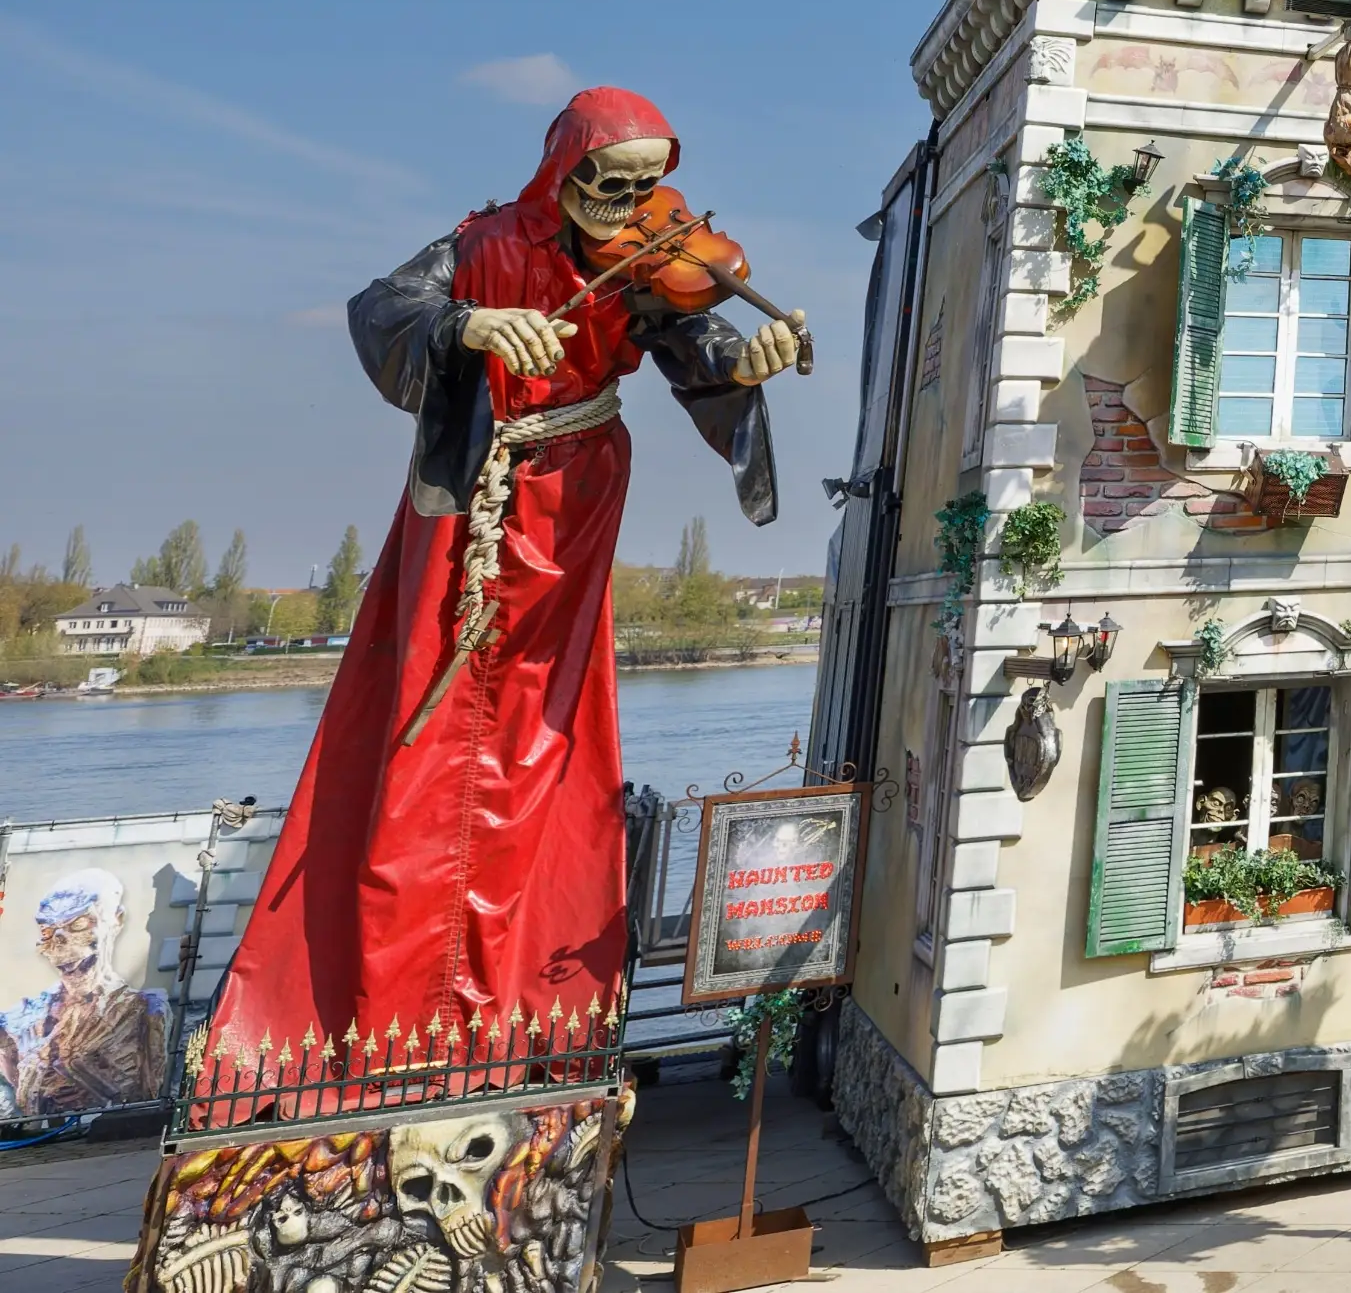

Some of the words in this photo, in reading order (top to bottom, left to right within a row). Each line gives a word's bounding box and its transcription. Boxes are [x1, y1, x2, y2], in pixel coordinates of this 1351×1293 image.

[727, 861, 834, 890] HAUNTED
[725, 891, 829, 921] MANSION
[725, 930, 823, 952] WELCOME
